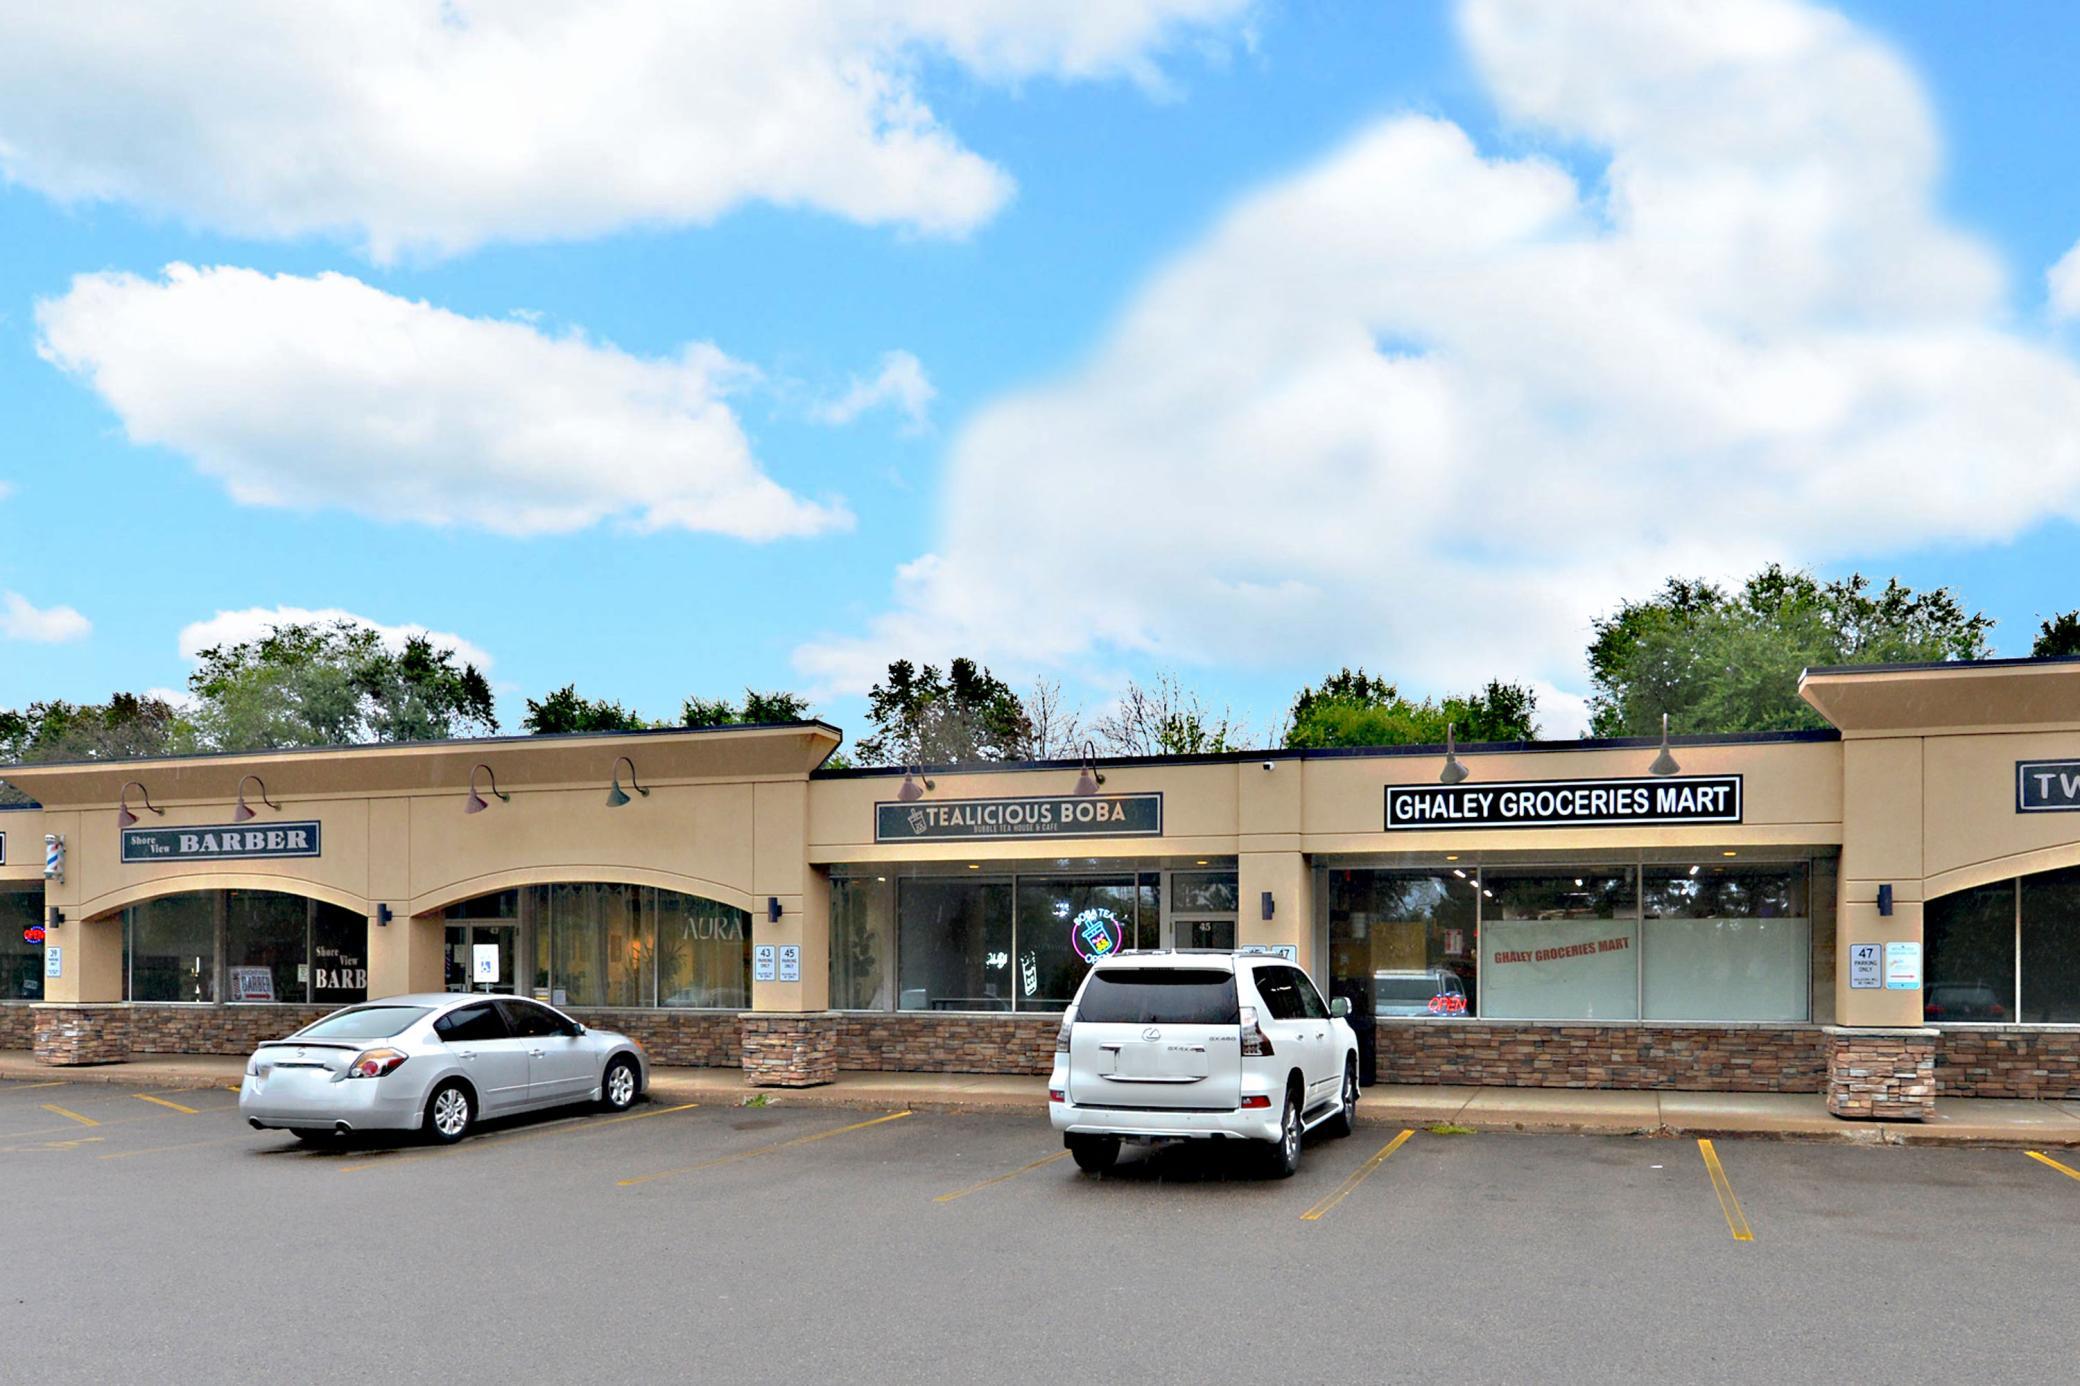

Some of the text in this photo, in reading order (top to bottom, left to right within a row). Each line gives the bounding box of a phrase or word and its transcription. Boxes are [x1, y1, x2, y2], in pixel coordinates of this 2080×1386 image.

[1395, 786, 1730, 819] GHALEY GROCERIES MART
[926, 802, 1125, 827] TEALICIOUS BOBA
[1000, 824, 1011, 833] TEA
[1013, 823, 1033, 832] HOUSE
[131, 836, 156, 846] Shore
[179, 830, 308, 852] BARBER
[151, 844, 170, 853] View
[1098, 908, 1117, 921] TEA
[683, 917, 744, 940] AURA
[315, 946, 339, 957] Shore
[760, 948, 771, 957] 43
[784, 948, 795, 957] 45
[1494, 937, 1629, 964] GHALEY GROCERIES MART
[1858, 948, 1873, 959] 47
[340, 955, 358, 965] View
[315, 968, 367, 989] BARB
[1428, 997, 1467, 1012] OPEN
